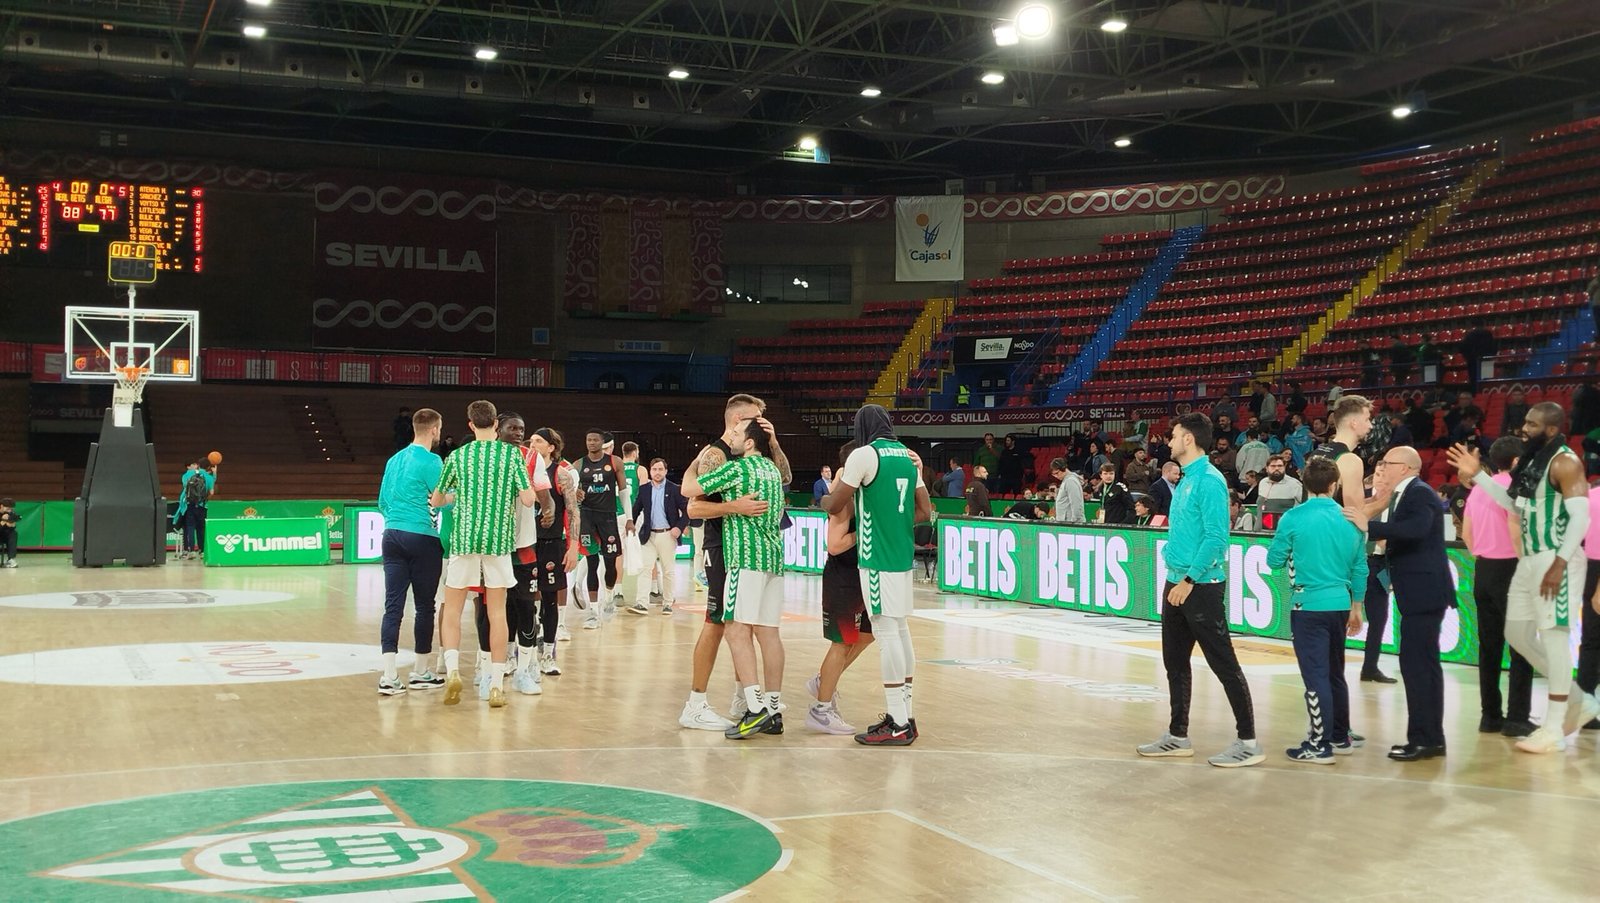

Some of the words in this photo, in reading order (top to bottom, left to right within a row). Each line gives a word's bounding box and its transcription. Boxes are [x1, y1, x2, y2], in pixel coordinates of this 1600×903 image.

[53, 183, 60, 191] 4
[119, 186, 126, 196] 5
[63, 206, 80, 218] 88
[99, 209, 115, 220] 77
[326, 242, 485, 273] SEVILLA
[910, 250, 951, 263] Cajasol
[60, 408, 104, 418] SEVILL
[950, 412, 990, 423] SEVILLA
[592, 473, 604, 483] 34
[896, 478, 908, 513] 7
[243, 532, 322, 552] hummel
[607, 543, 617, 553] 34
[944, 524, 1016, 595] BETIS
[1039, 531, 1129, 610] BETIS
[548, 572, 555, 584] 5
